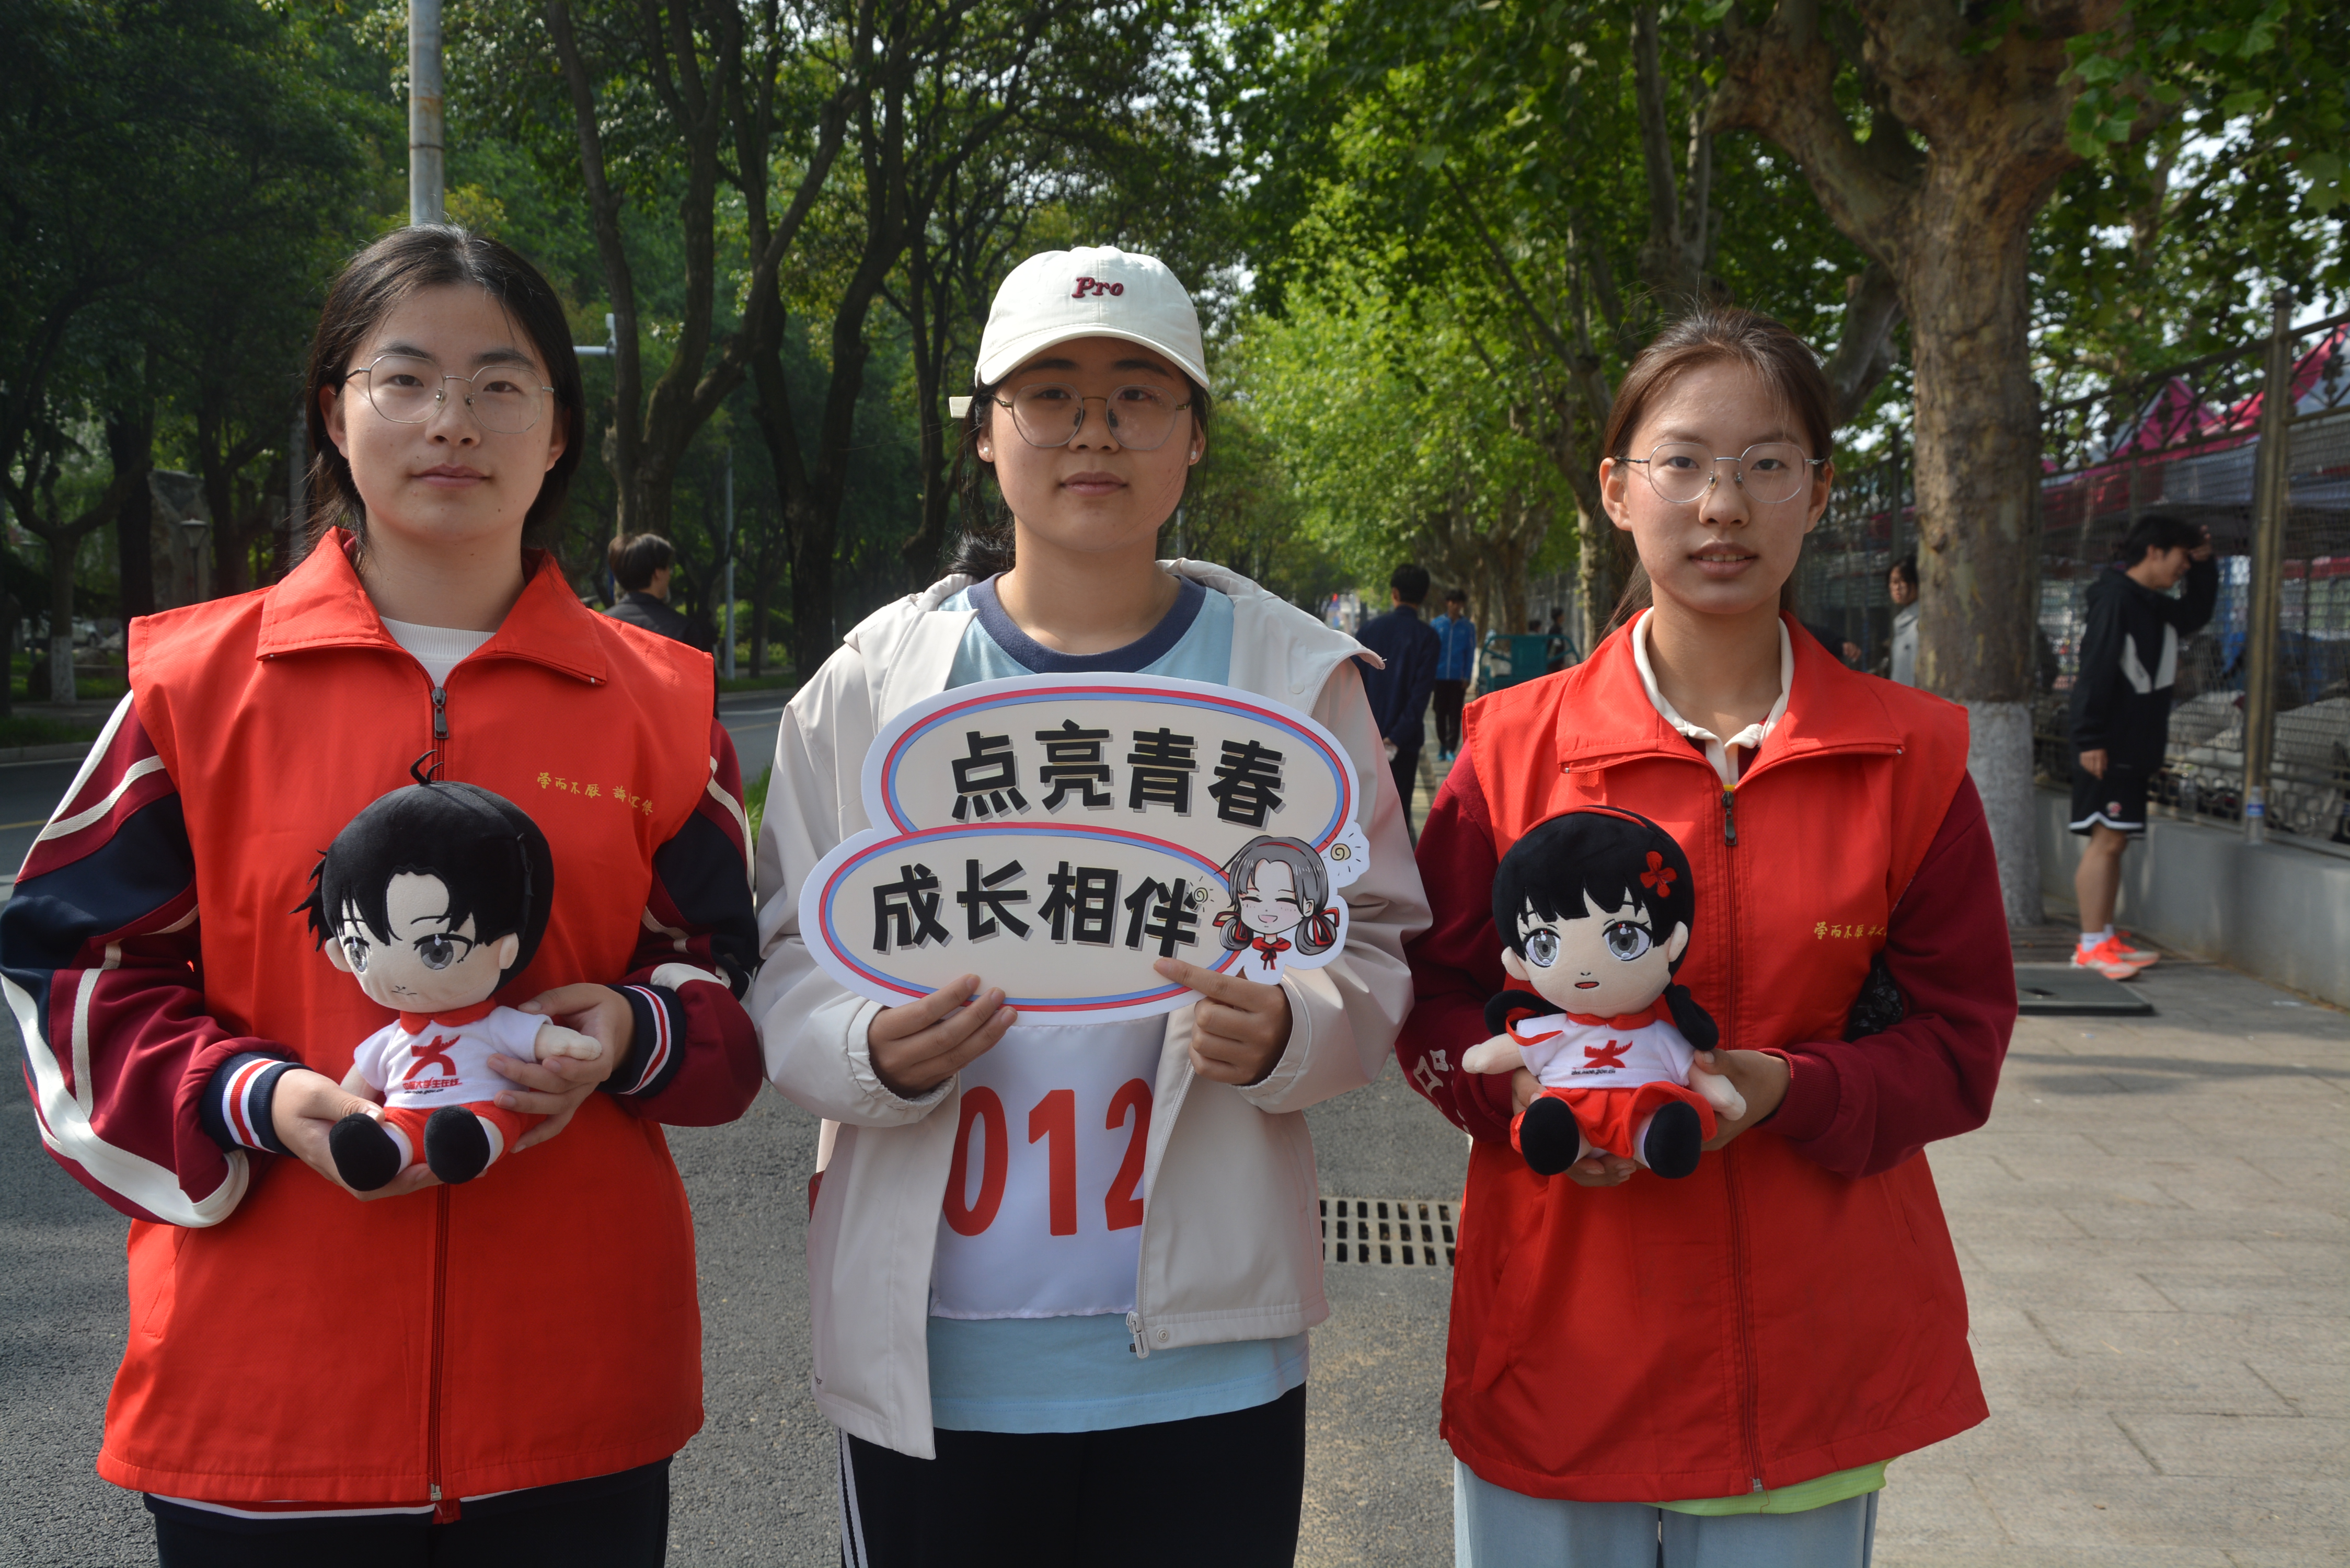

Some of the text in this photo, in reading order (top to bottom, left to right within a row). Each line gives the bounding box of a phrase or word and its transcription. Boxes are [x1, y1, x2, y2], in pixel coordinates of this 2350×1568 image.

[1072, 277, 1124, 298] Pro
[951, 719, 1285, 829] 点亮青春
[872, 859, 1203, 958] 成长相伴
[942, 1078, 1154, 1236] 012
